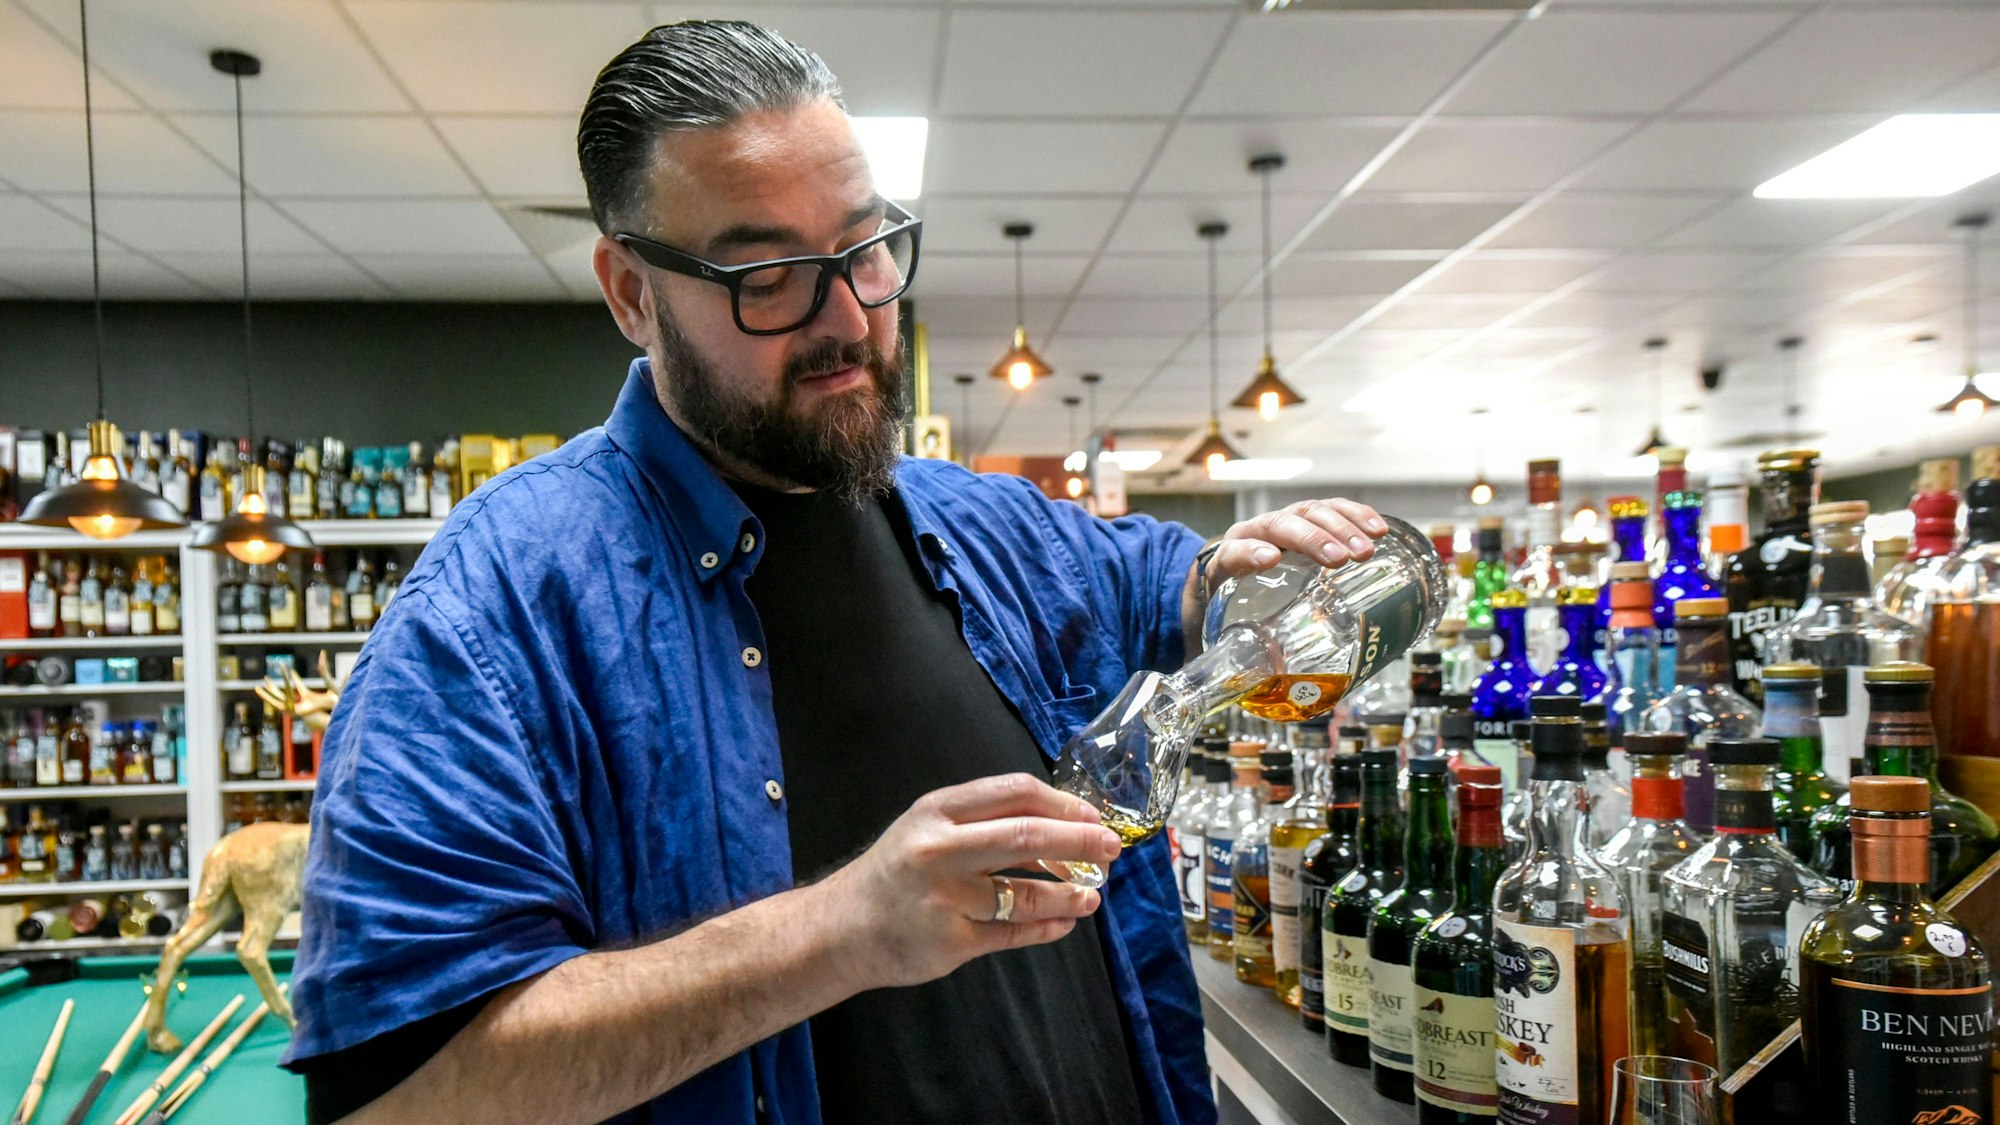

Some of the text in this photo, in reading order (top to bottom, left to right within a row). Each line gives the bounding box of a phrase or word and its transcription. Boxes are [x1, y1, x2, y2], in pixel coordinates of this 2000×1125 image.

[1661, 939, 1710, 974] BUSHMILLS
[1338, 994, 1354, 1011] 15
[1861, 1008, 1929, 1036] BEN
[1881, 1042, 1942, 1053] HIGHLAND
[1944, 1044, 1976, 1053] SINGLE
[1905, 1055, 1950, 1065] SCOTCH
[1428, 1060, 1446, 1080] 12
